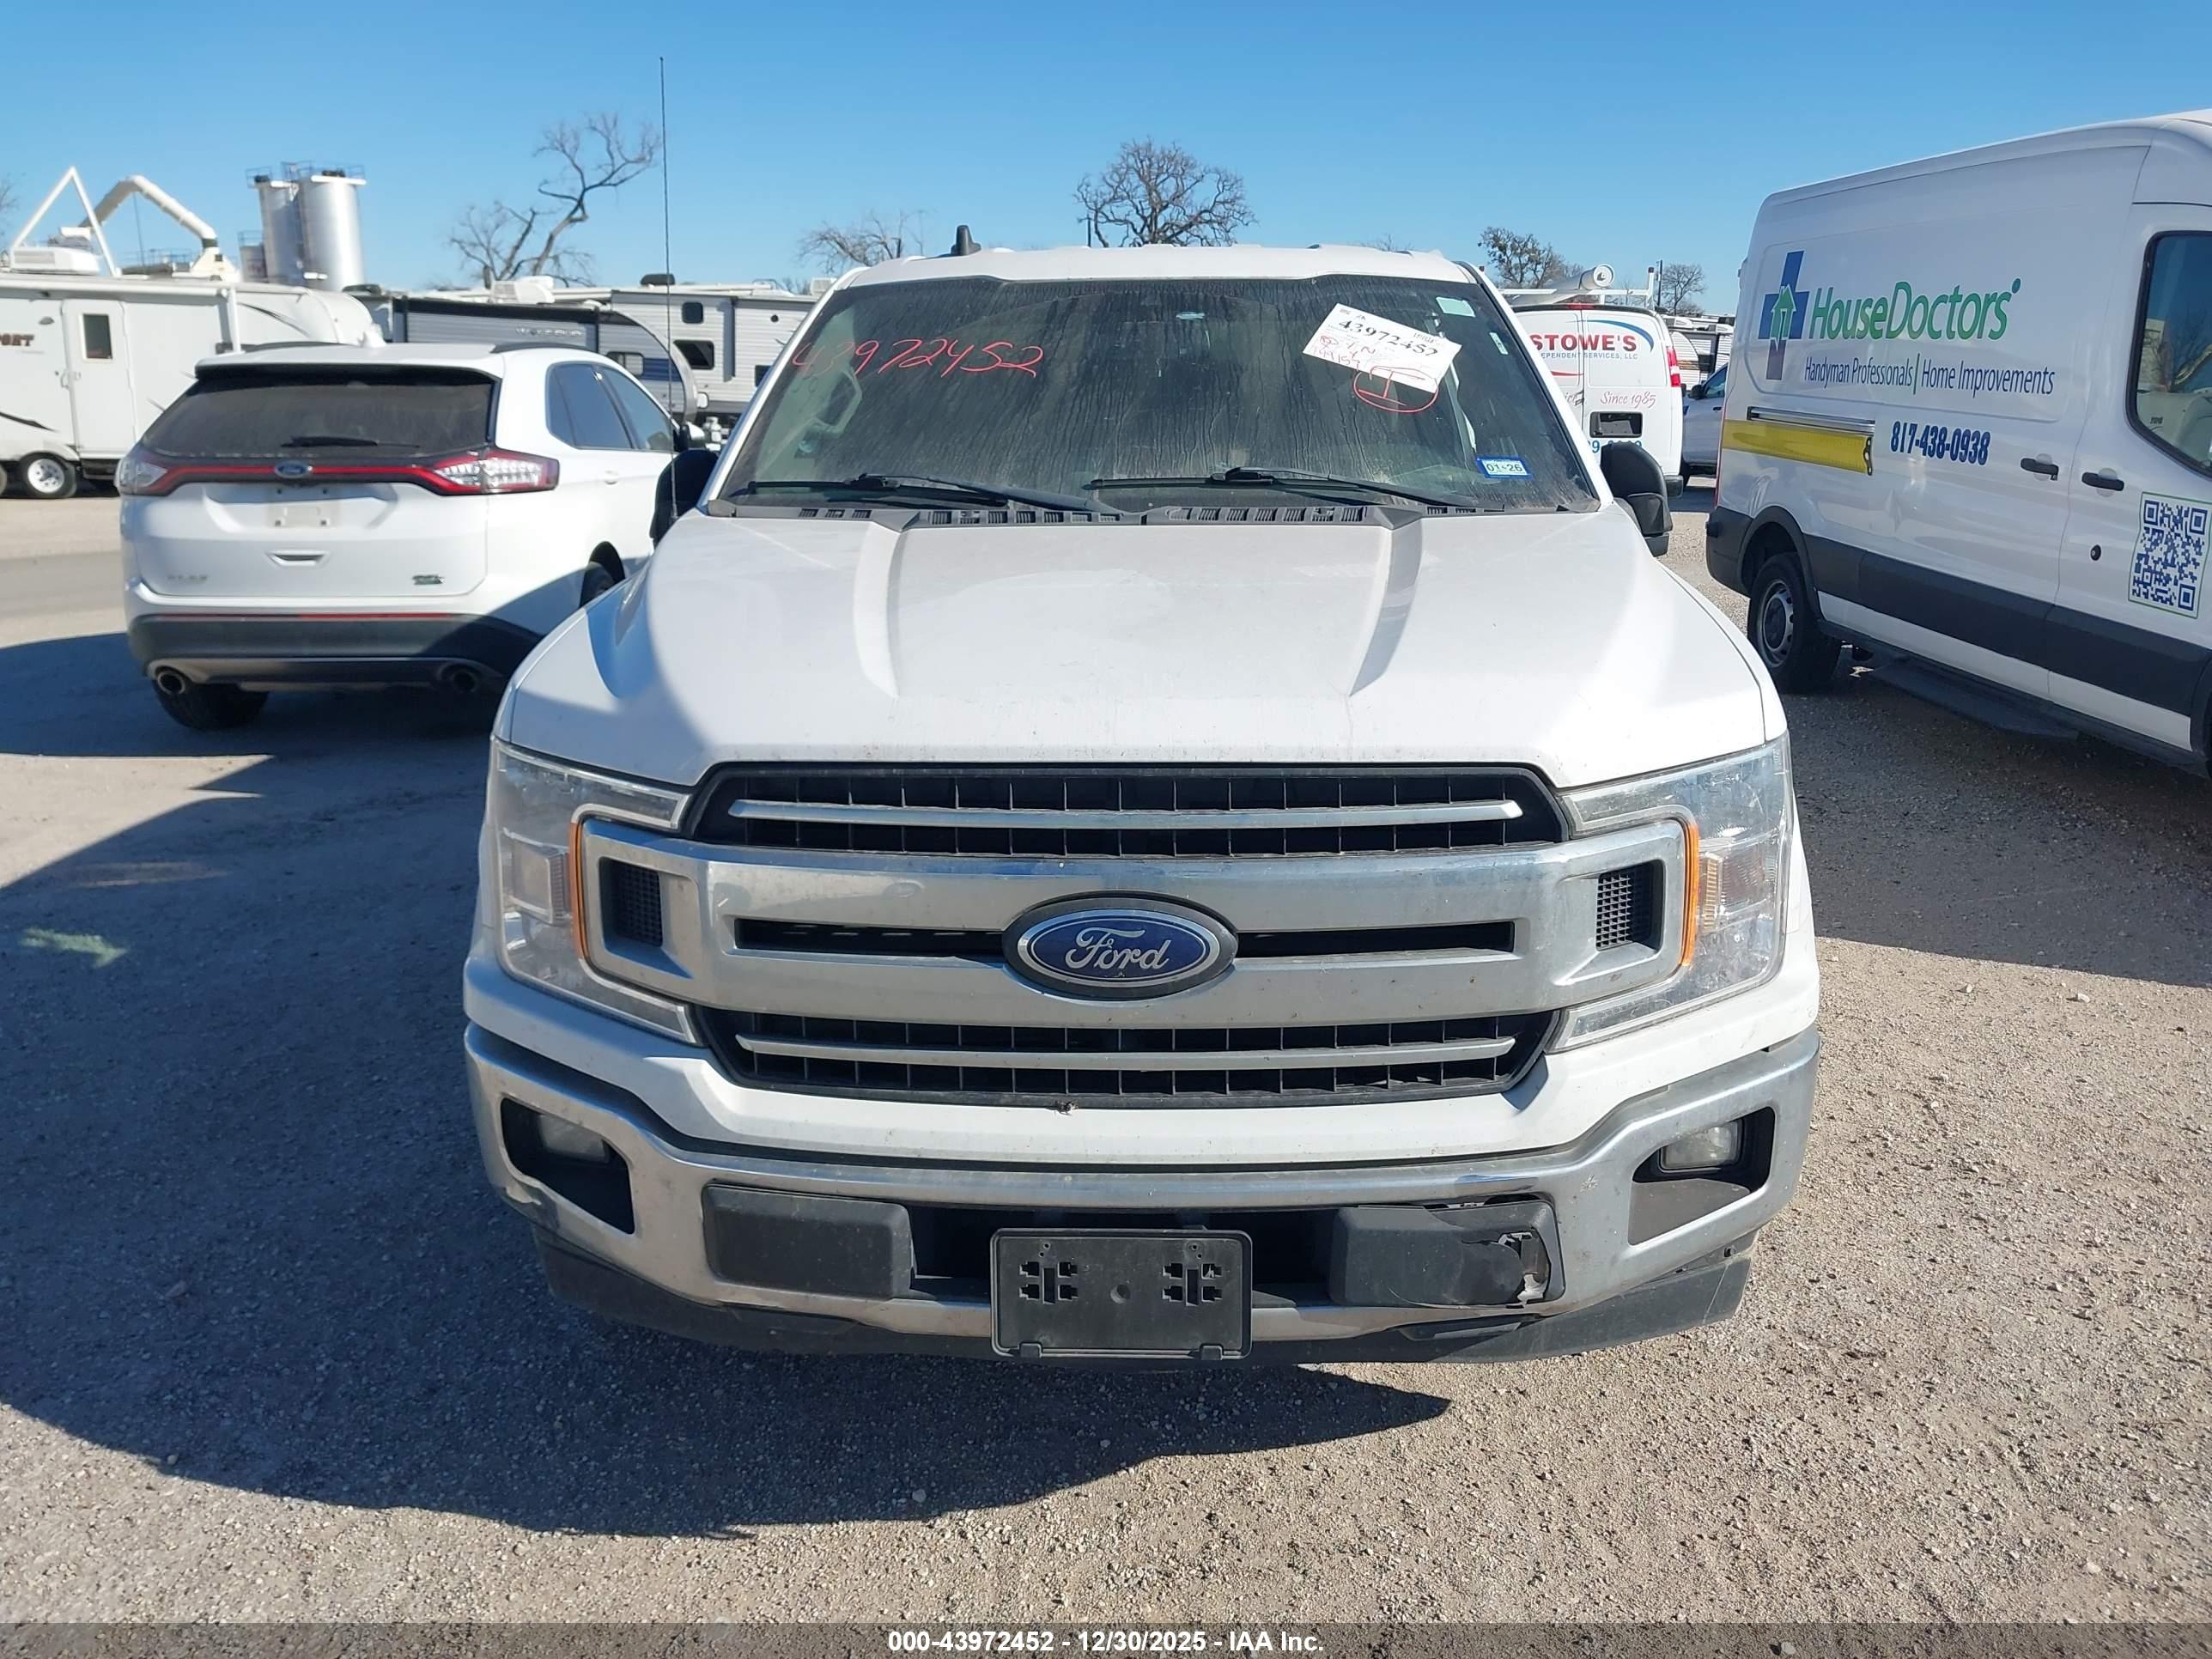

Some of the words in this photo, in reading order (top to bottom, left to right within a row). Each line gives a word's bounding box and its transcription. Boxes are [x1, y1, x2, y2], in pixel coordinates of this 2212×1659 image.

[1808, 281, 2012, 341] HouseDoctors
[1529, 334, 1637, 352] STOWE'S
[1805, 356, 1850, 389] Handyman
[1852, 357, 1913, 386] Professionals
[1922, 358, 1955, 389] Home
[1959, 360, 2056, 398] Improvements
[1600, 391, 1628, 404] Since
[1631, 391, 1656, 409] 1985
[1891, 421, 1991, 466] 817-438-0938
[1065, 927, 1171, 969] Ford
